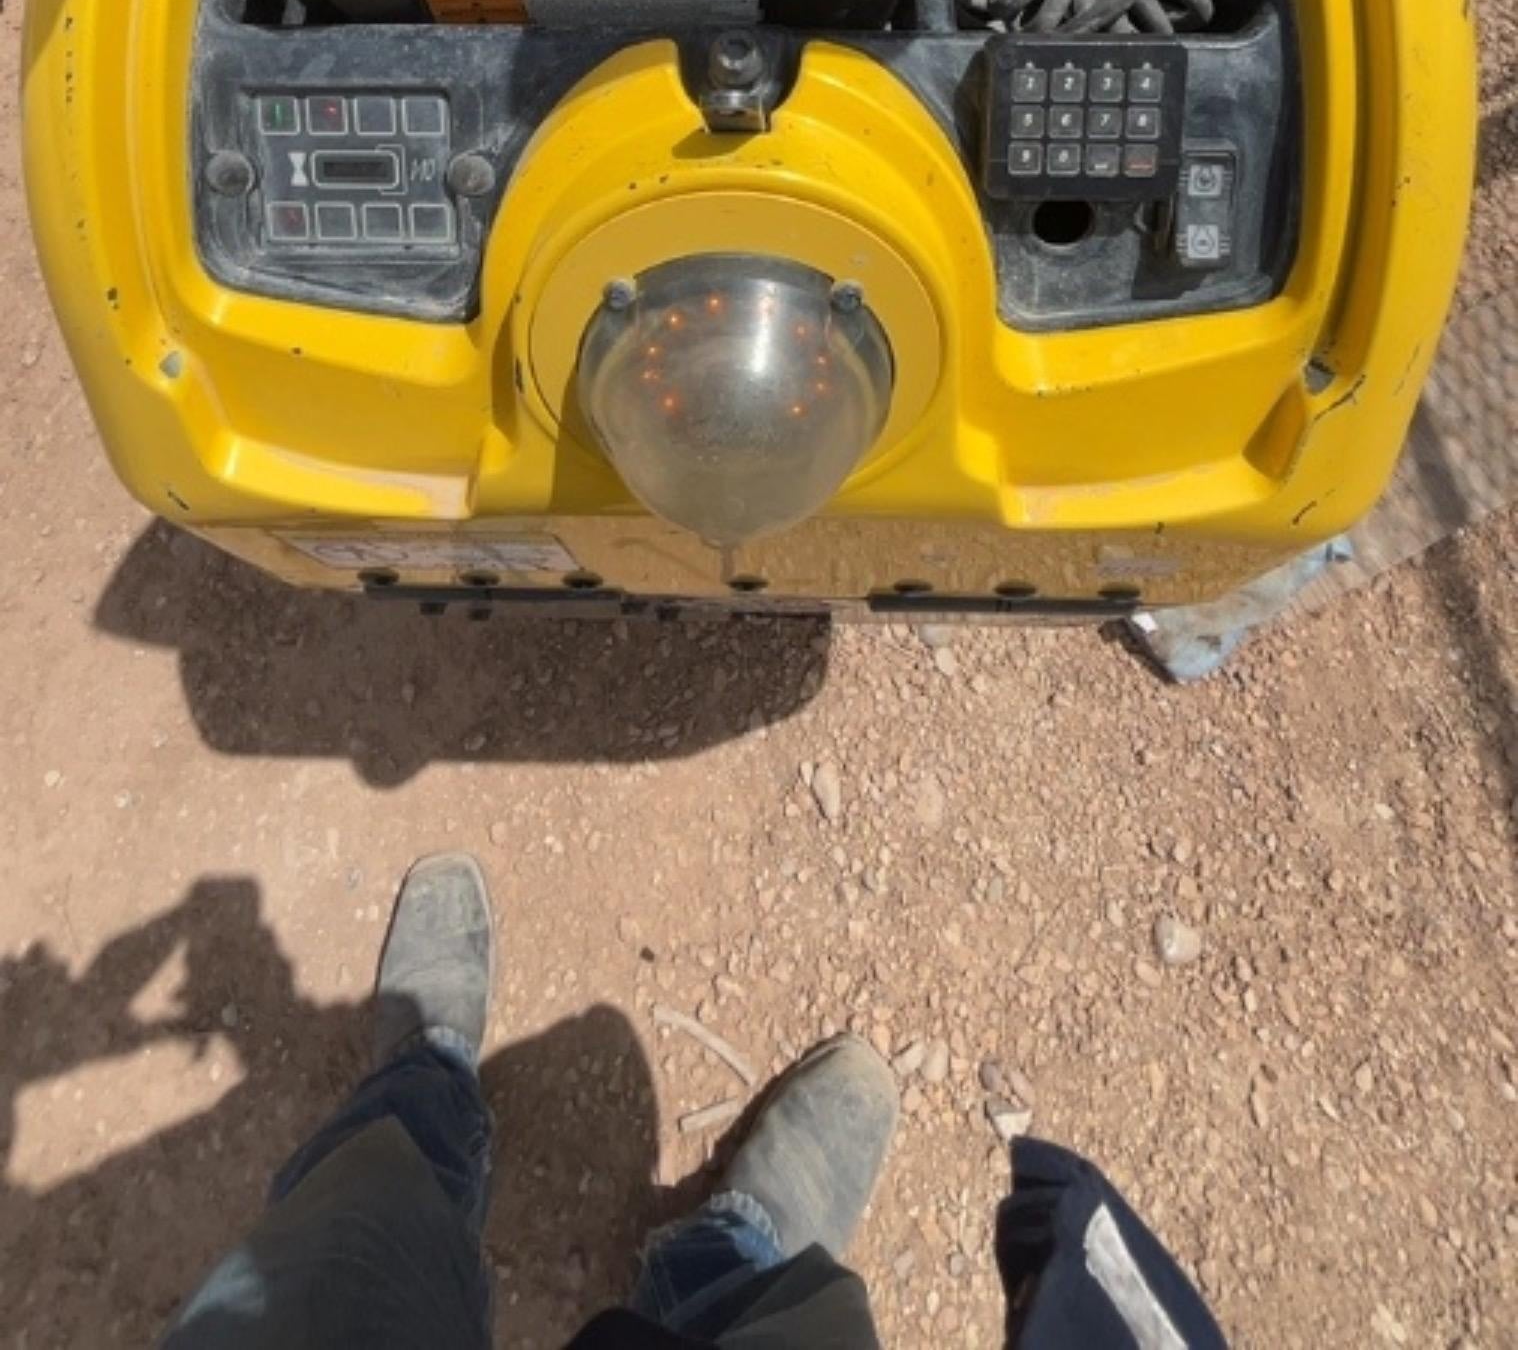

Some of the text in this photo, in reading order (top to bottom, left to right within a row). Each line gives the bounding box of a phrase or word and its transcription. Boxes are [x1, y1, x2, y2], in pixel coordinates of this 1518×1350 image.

[1026, 76, 1151, 91] 1 2 3 4
[1023, 113, 1147, 127] 5 6 7 8
[1021, 149, 1031, 163] 9
